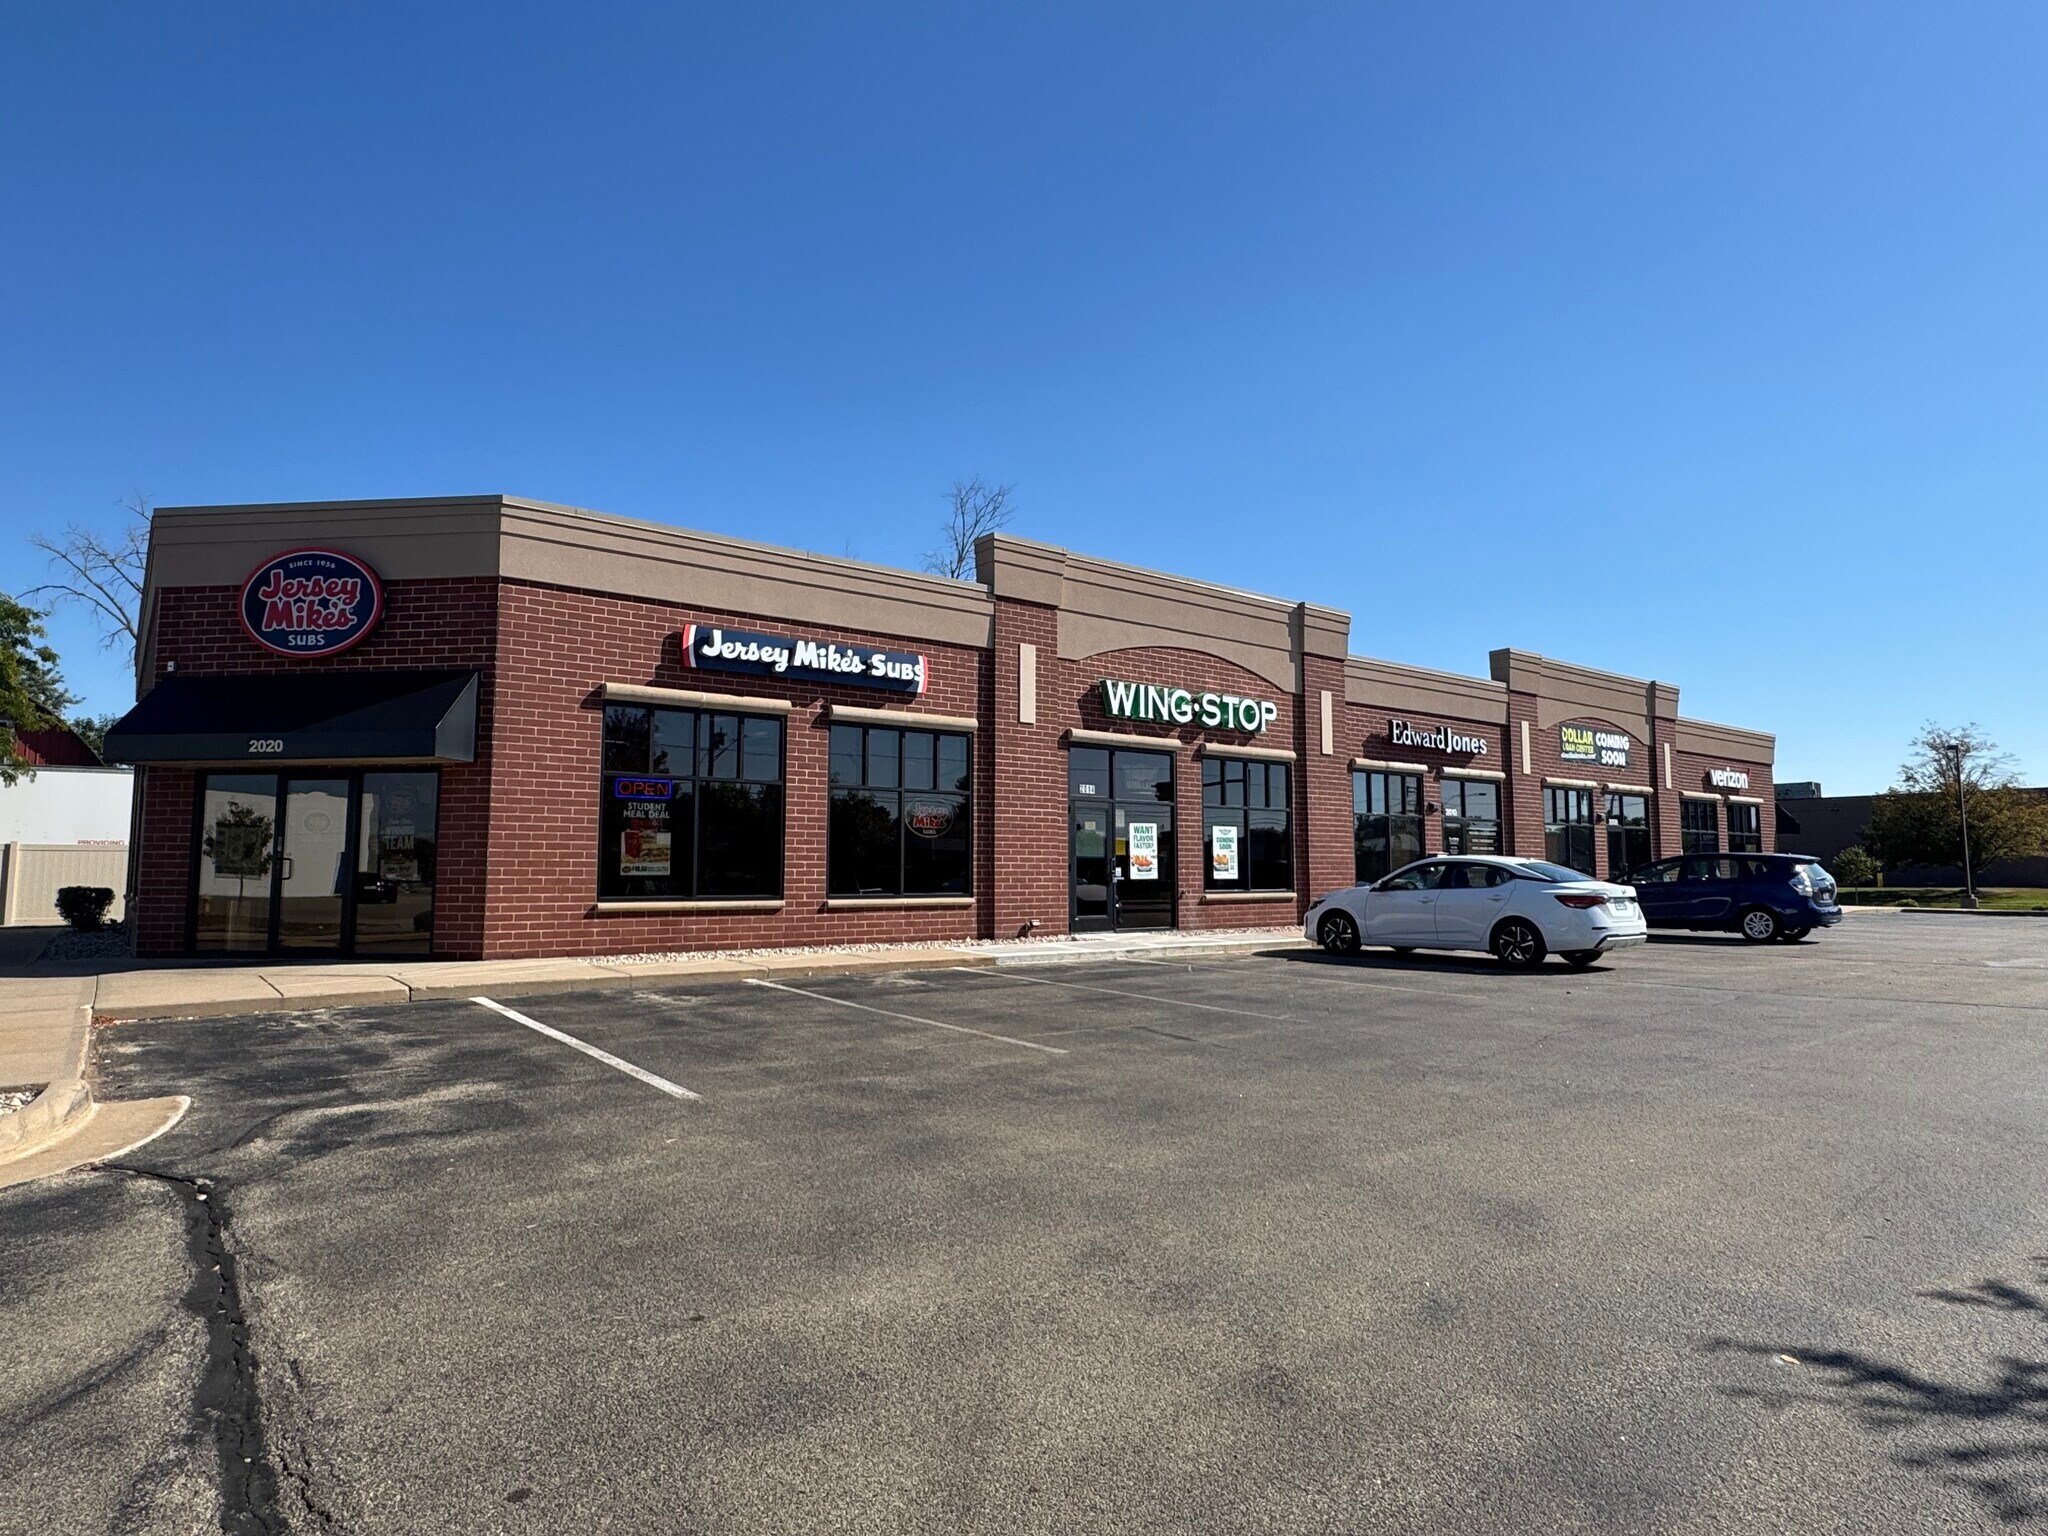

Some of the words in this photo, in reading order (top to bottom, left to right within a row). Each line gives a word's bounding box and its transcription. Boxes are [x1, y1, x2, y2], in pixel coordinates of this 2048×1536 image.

[289, 560, 313, 569] SINCE
[259, 569, 361, 606] Jersey
[262, 598, 357, 632] Mike's
[288, 634, 325, 646] SUBS
[702, 629, 789, 672] Jersey
[793, 640, 866, 674] Mike's
[1561, 726, 1594, 745] DOLLAR
[1595, 732, 1630, 751] COMING
[248, 739, 283, 753] 2020
[1601, 749, 1626, 766] SOON
[1711, 766, 1749, 789] verizon
[618, 781, 669, 796] OPEN
[627, 802, 667, 811] STUDENT
[623, 810, 646, 818] MEAL
[648, 810, 670, 819] DEAL
[1133, 825, 1154, 834] WANT
[382, 835, 415, 850] TEAM
